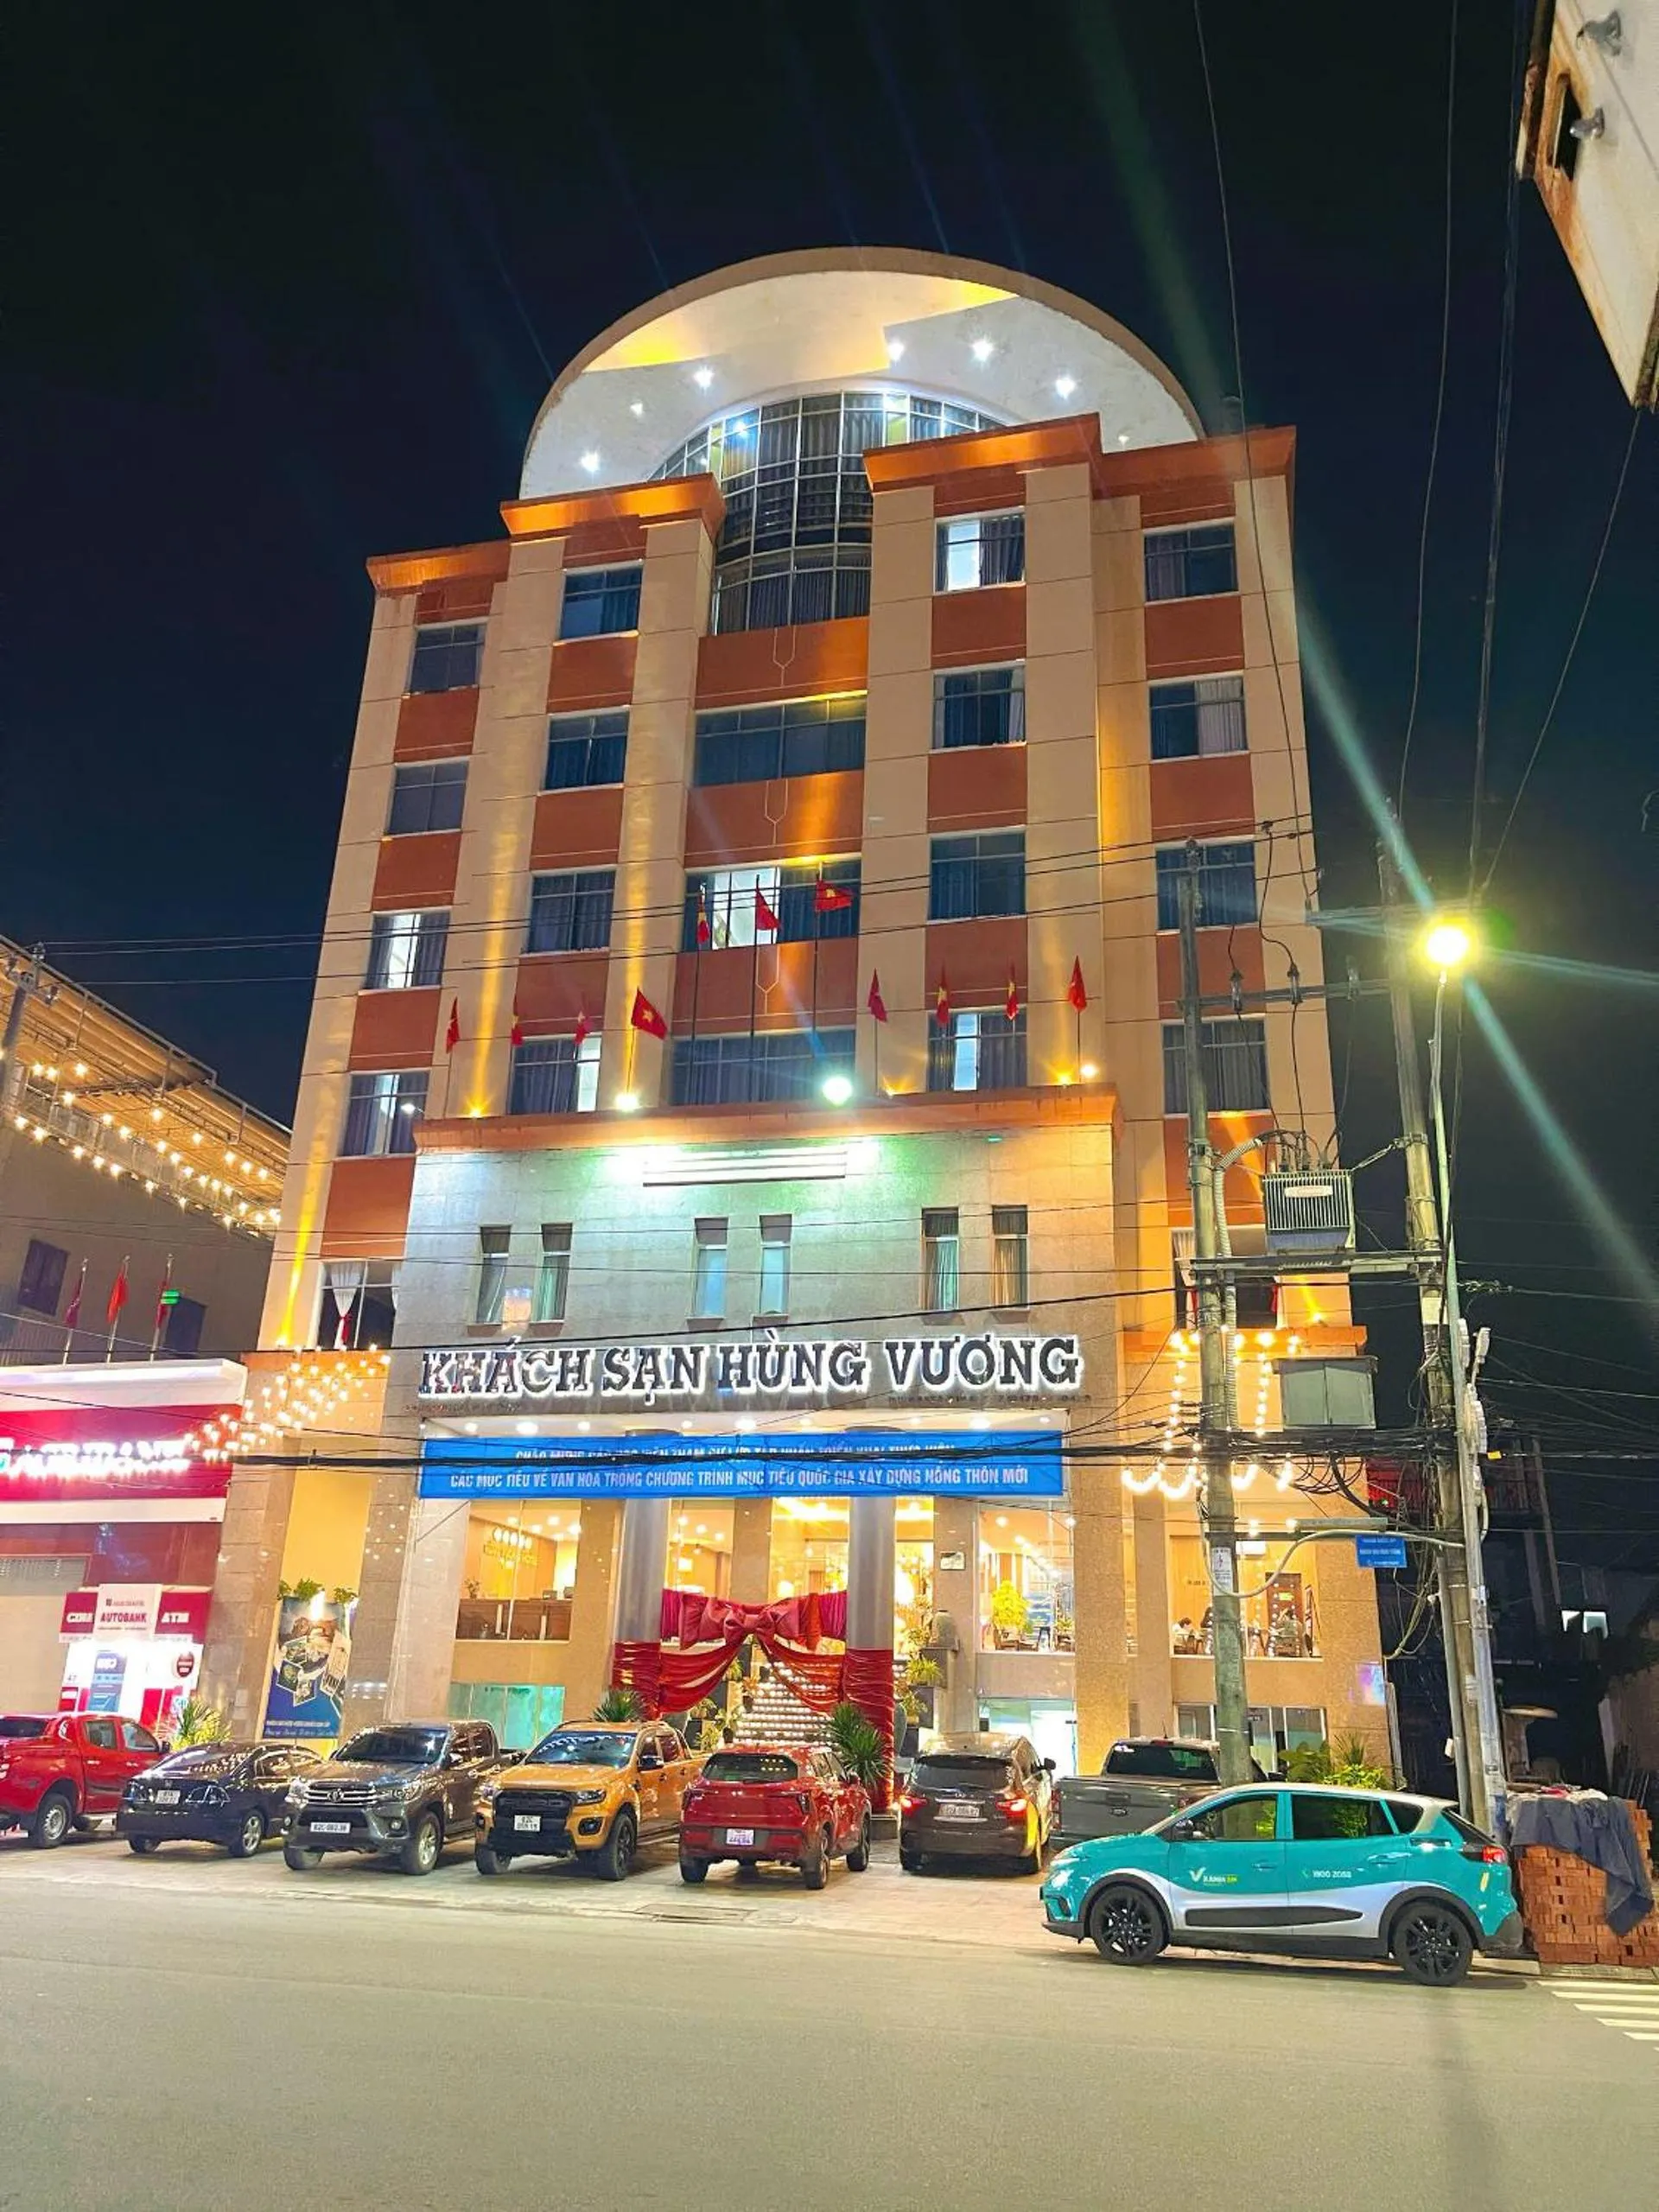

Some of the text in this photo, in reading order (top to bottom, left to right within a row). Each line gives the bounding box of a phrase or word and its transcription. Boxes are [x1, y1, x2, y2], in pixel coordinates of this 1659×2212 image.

[417, 1329, 1082, 1405] KHÁCH SẠN HÙNG VƯƠNG
[605, 1471, 642, 1487] TRONG
